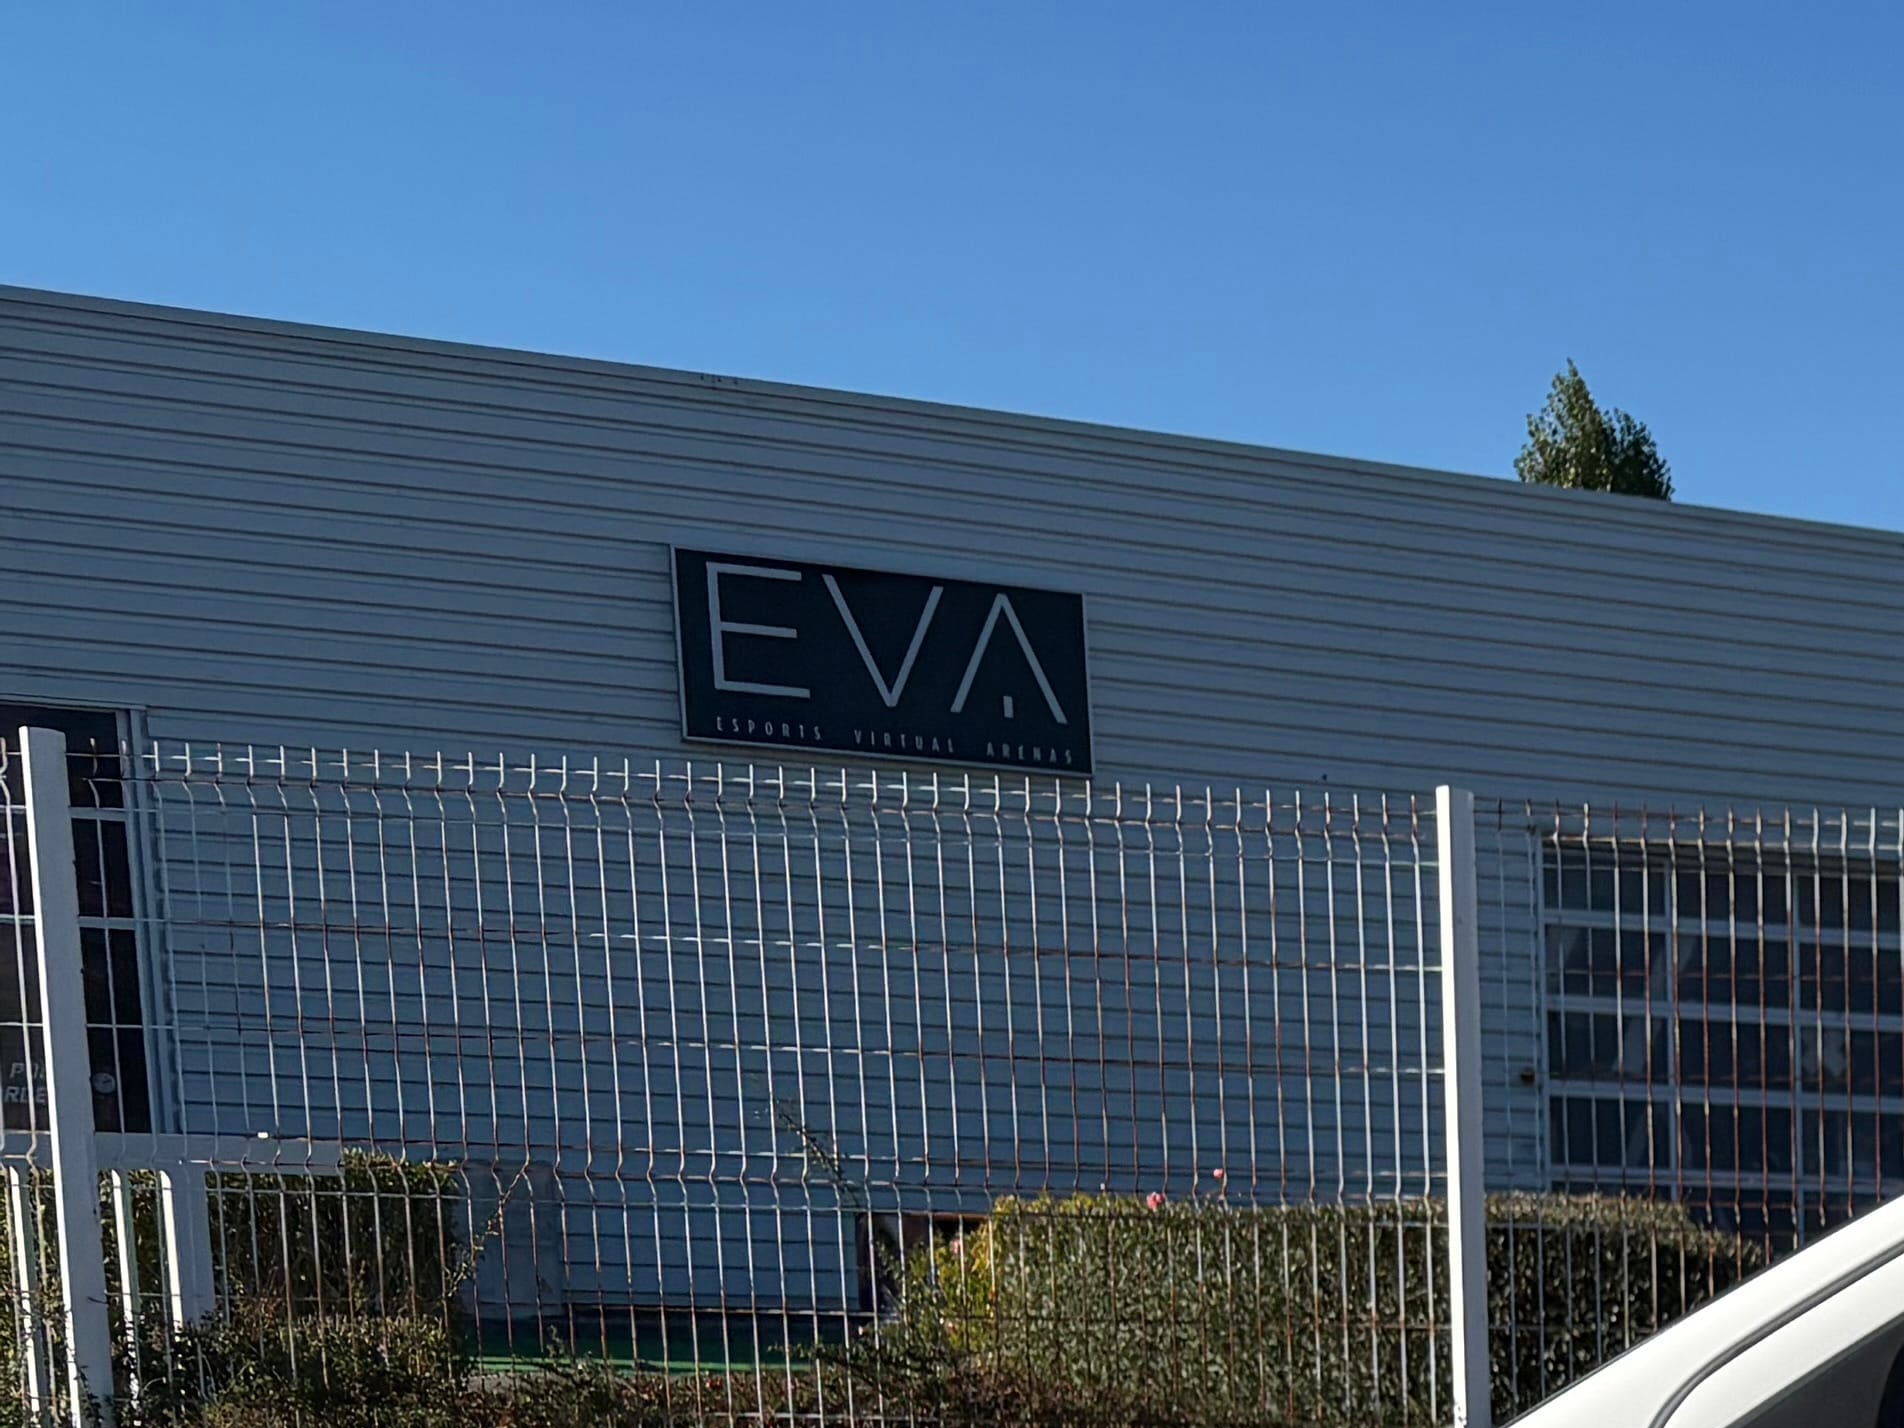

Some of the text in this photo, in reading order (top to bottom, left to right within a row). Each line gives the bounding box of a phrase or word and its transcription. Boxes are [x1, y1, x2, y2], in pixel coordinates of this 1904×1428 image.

[706, 561, 1068, 724] EVA
[716, 715, 1072, 765] ESPORTS VIRTUAL ARENAS
